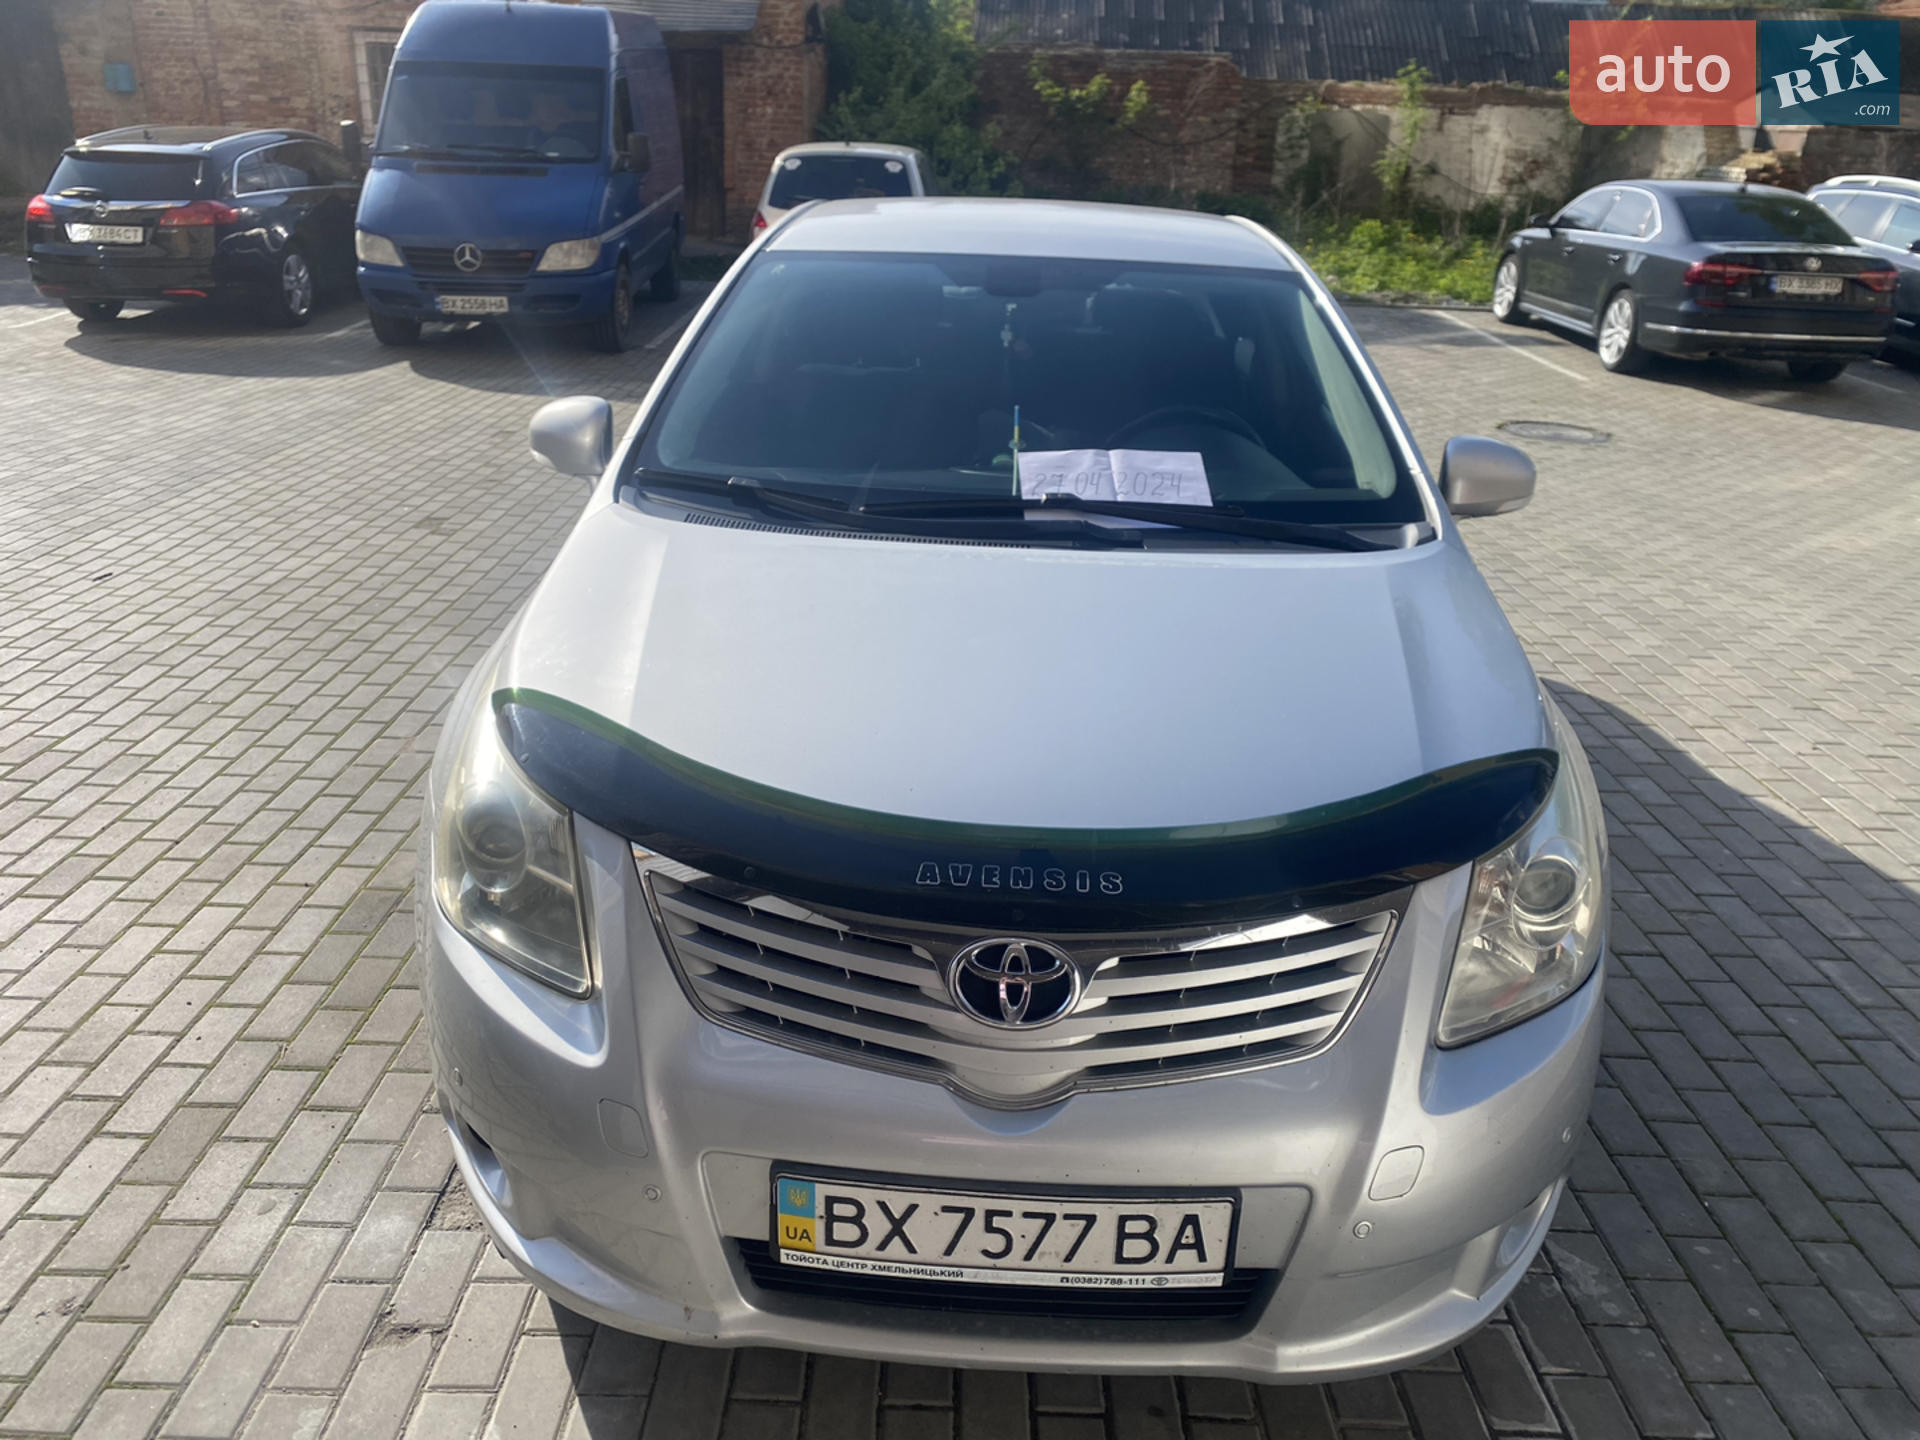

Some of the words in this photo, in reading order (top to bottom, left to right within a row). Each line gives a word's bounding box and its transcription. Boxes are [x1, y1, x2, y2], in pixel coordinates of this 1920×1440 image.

[1074, 471, 1101, 495] 04
[1117, 471, 1182, 497] 2024
[915, 861, 1123, 895] AVENSIS
[785, 1226, 812, 1243] UA
[824, 1194, 919, 1255] BX
[940, 1205, 1098, 1264] 7577
[1114, 1213, 1208, 1266] BA
[784, 1252, 829, 1267] ТОЙОТА
[832, 1260, 869, 1272] ЦЕНТР
[870, 1264, 964, 1279] ХМЕЛЬНИЦЬКИЙ
